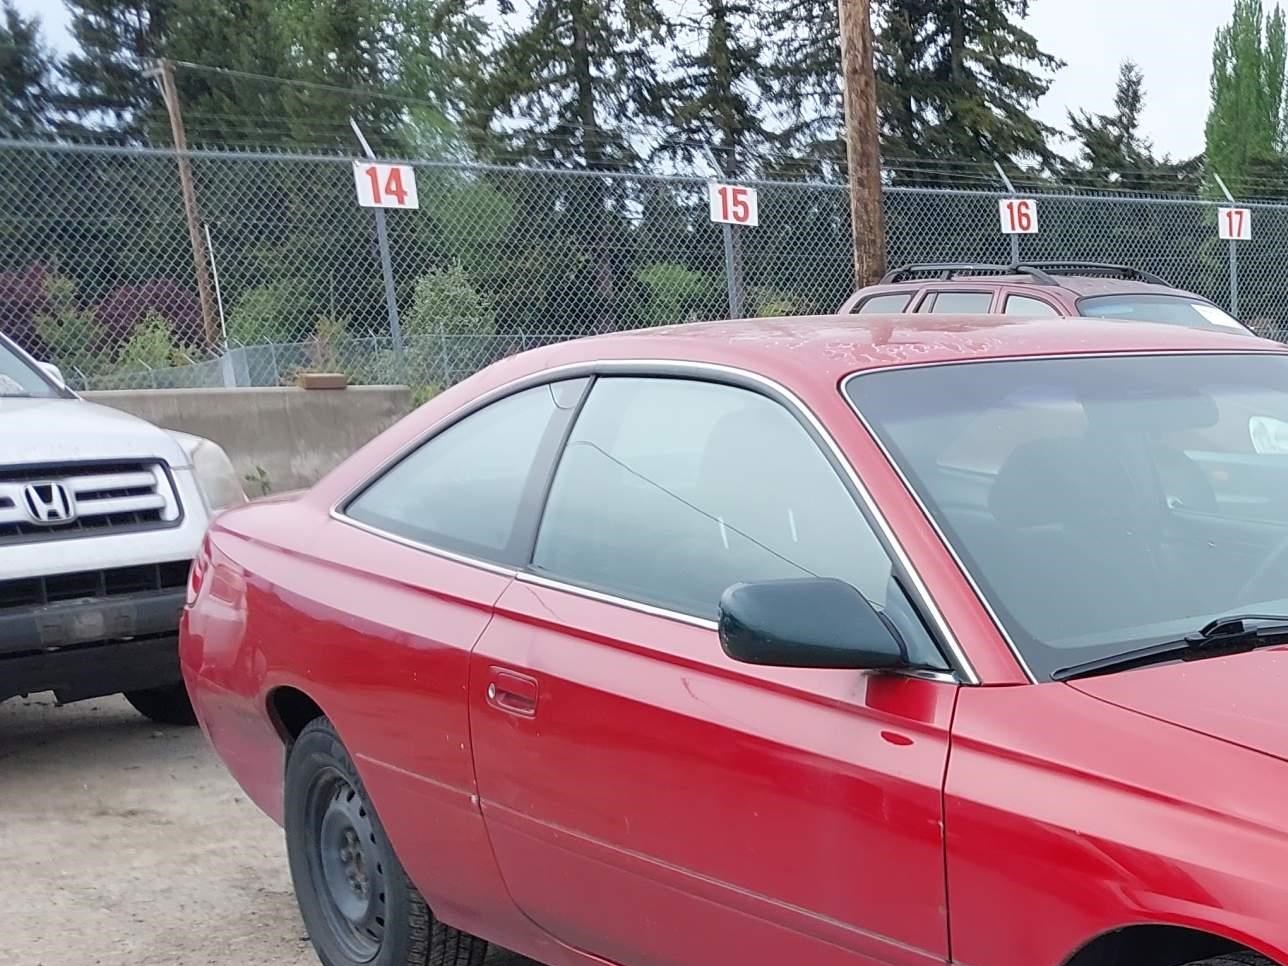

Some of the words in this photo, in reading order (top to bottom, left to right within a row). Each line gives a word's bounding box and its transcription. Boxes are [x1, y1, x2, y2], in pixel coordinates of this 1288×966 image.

[365, 167, 407, 205] 14
[719, 187, 750, 222] 15
[1006, 201, 1031, 231] 16
[1226, 210, 1244, 237] 17
